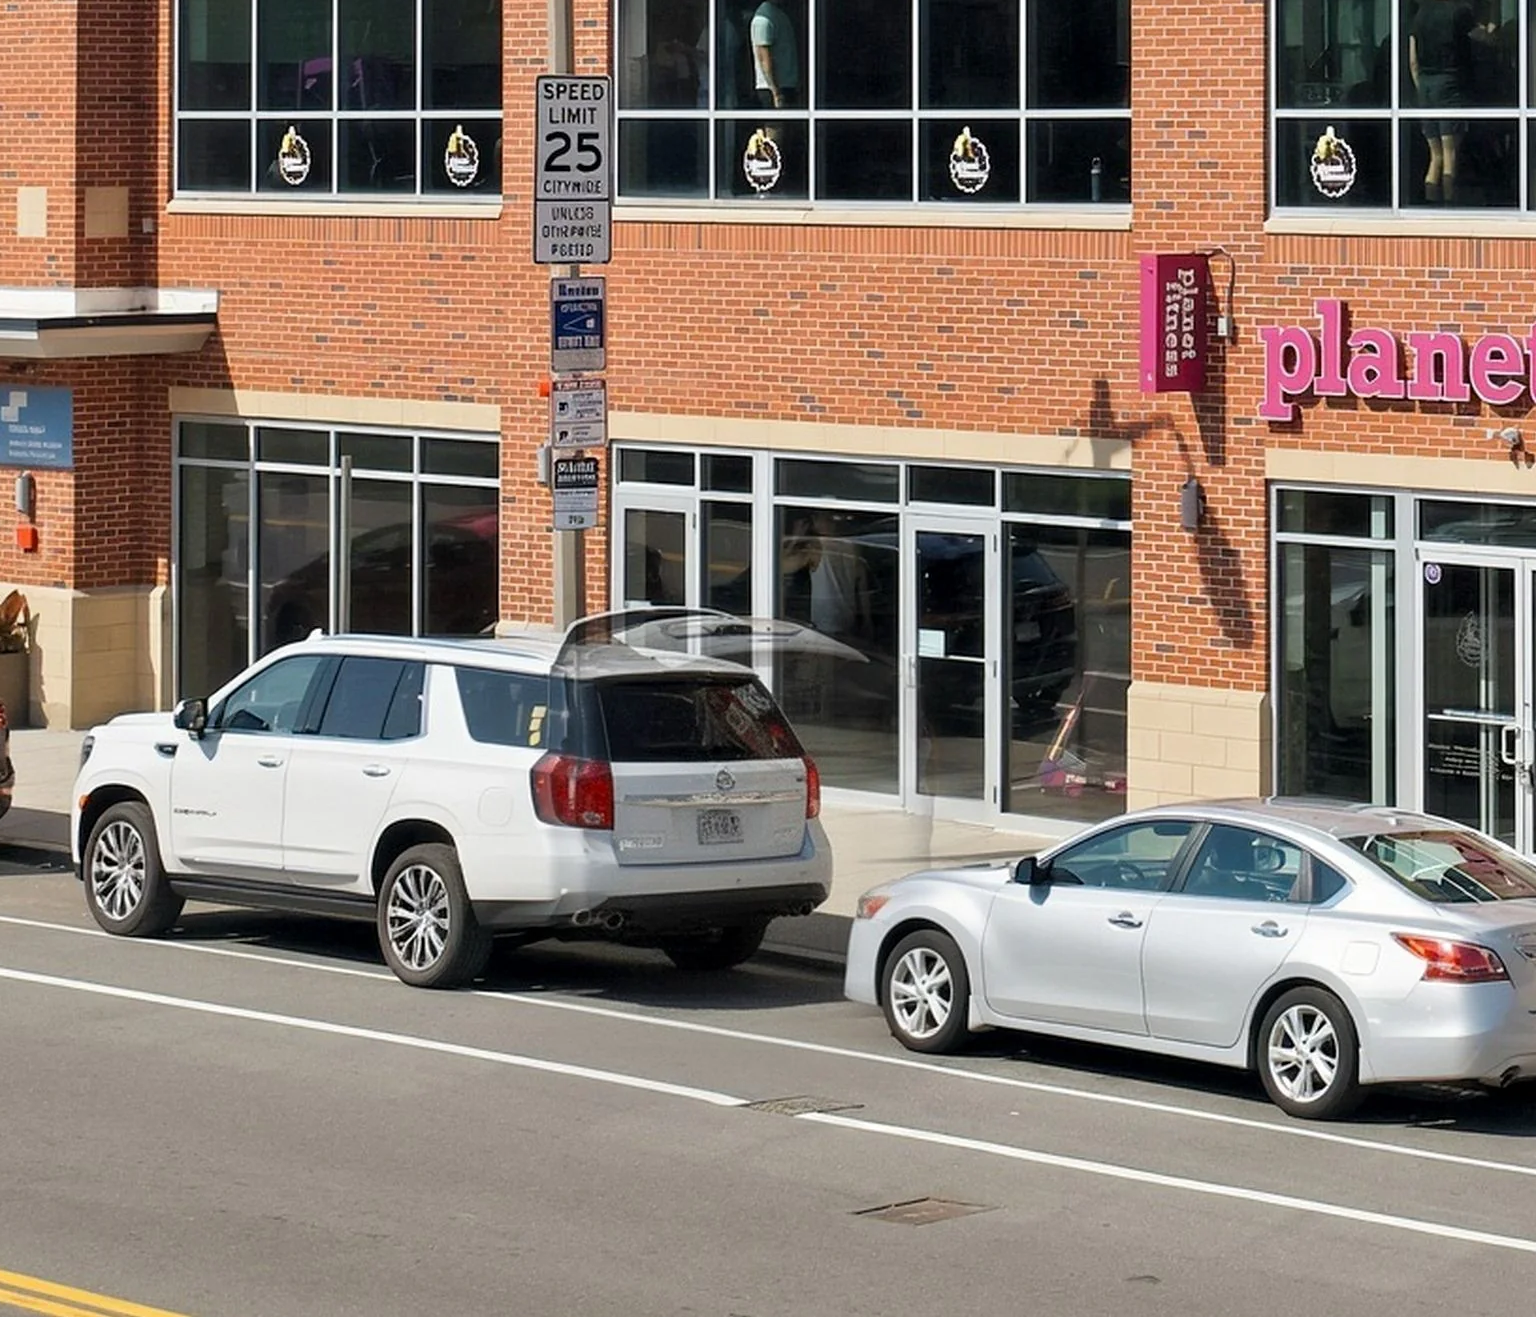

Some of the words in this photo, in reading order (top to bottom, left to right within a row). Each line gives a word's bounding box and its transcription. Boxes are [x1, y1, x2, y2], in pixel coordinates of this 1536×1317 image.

[544, 83, 604, 101] SPEED
[549, 107, 597, 124] LIMIT
[545, 131, 602, 173] 25
[1165, 282, 1182, 377] fitness
[1178, 269, 1198, 359] planet
